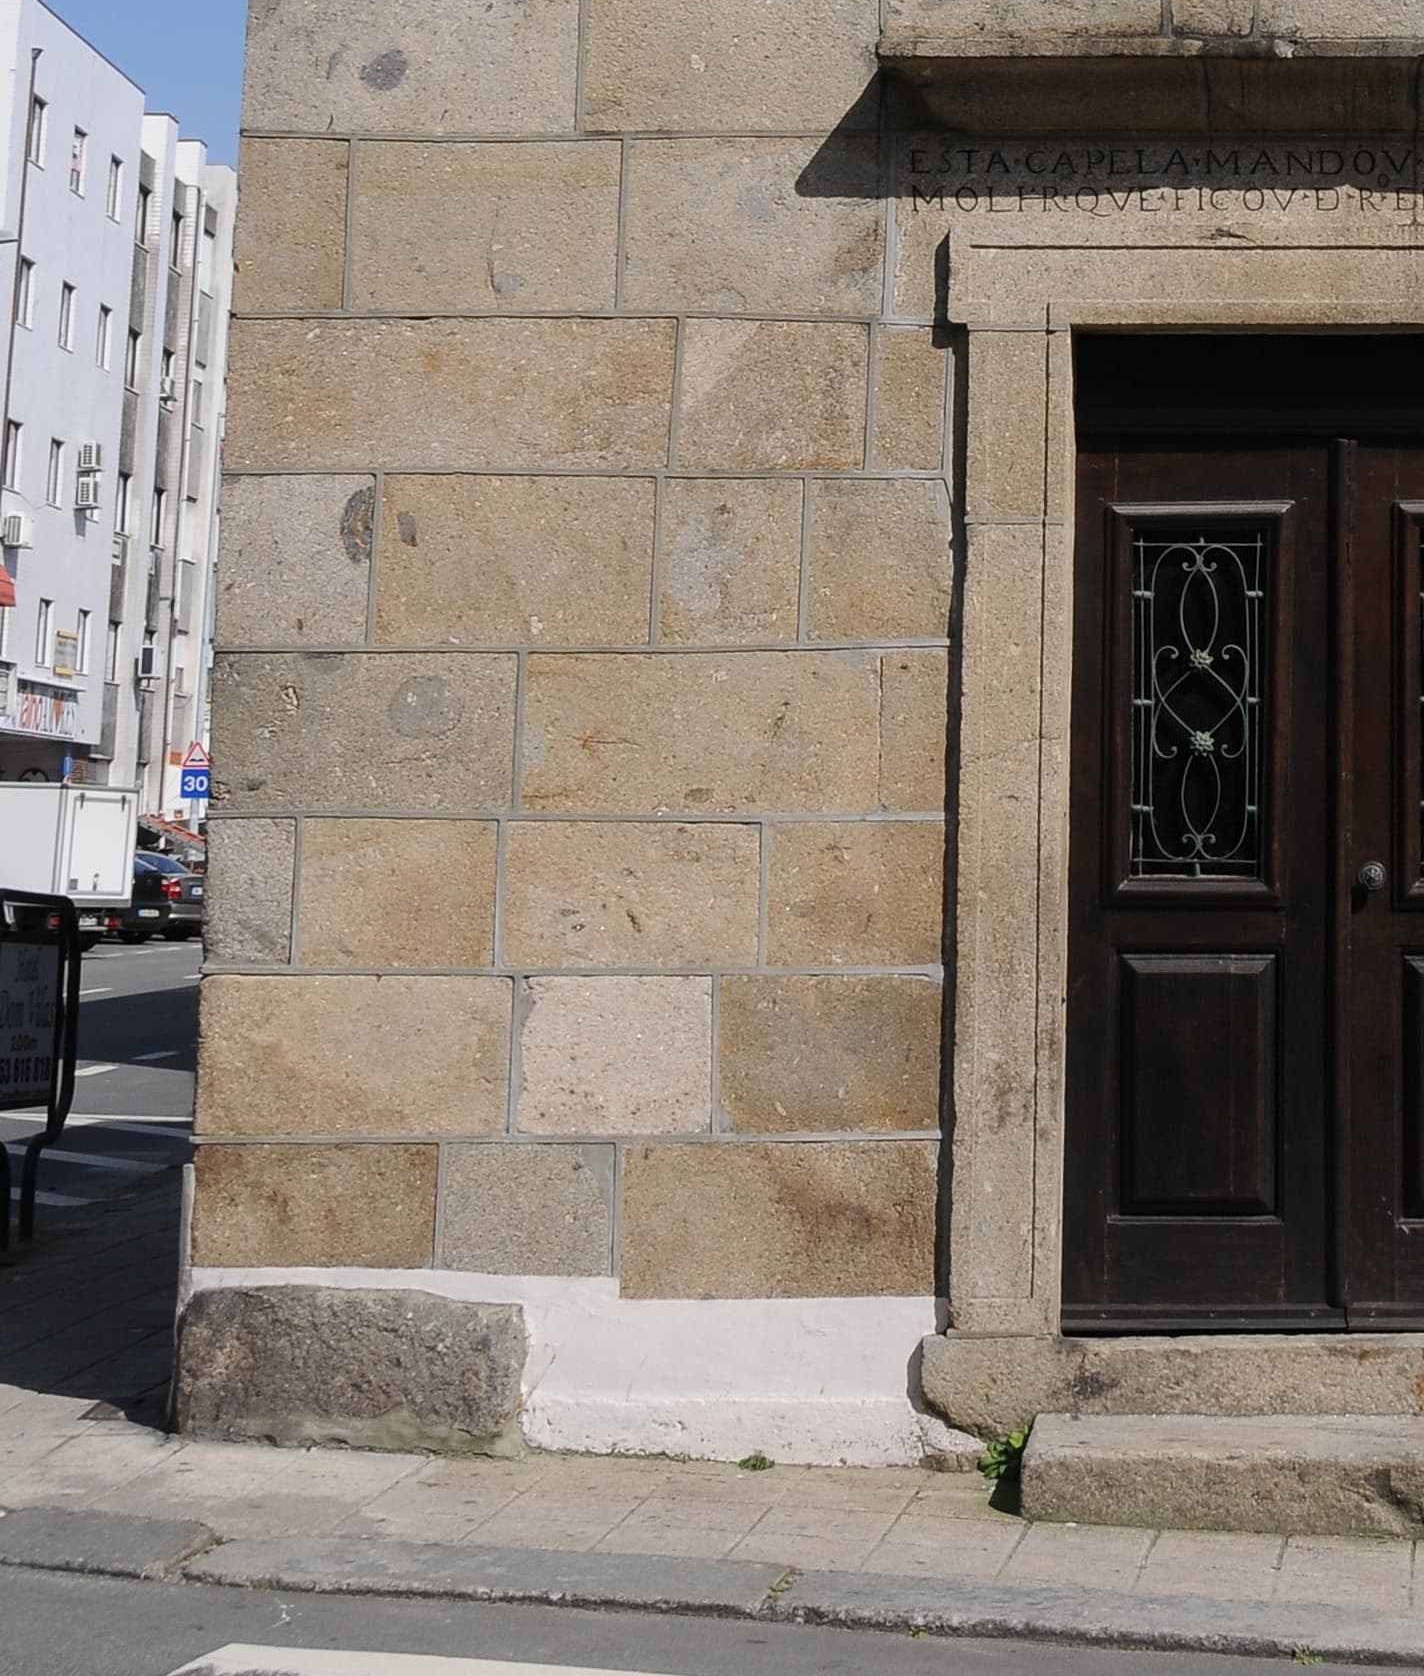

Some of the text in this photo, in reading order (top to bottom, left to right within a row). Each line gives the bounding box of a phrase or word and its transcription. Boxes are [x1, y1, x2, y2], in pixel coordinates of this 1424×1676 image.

[909, 149, 1011, 175] ESTA
[1024, 149, 1191, 175] CAPELA
[183, 775, 208, 792] 30
